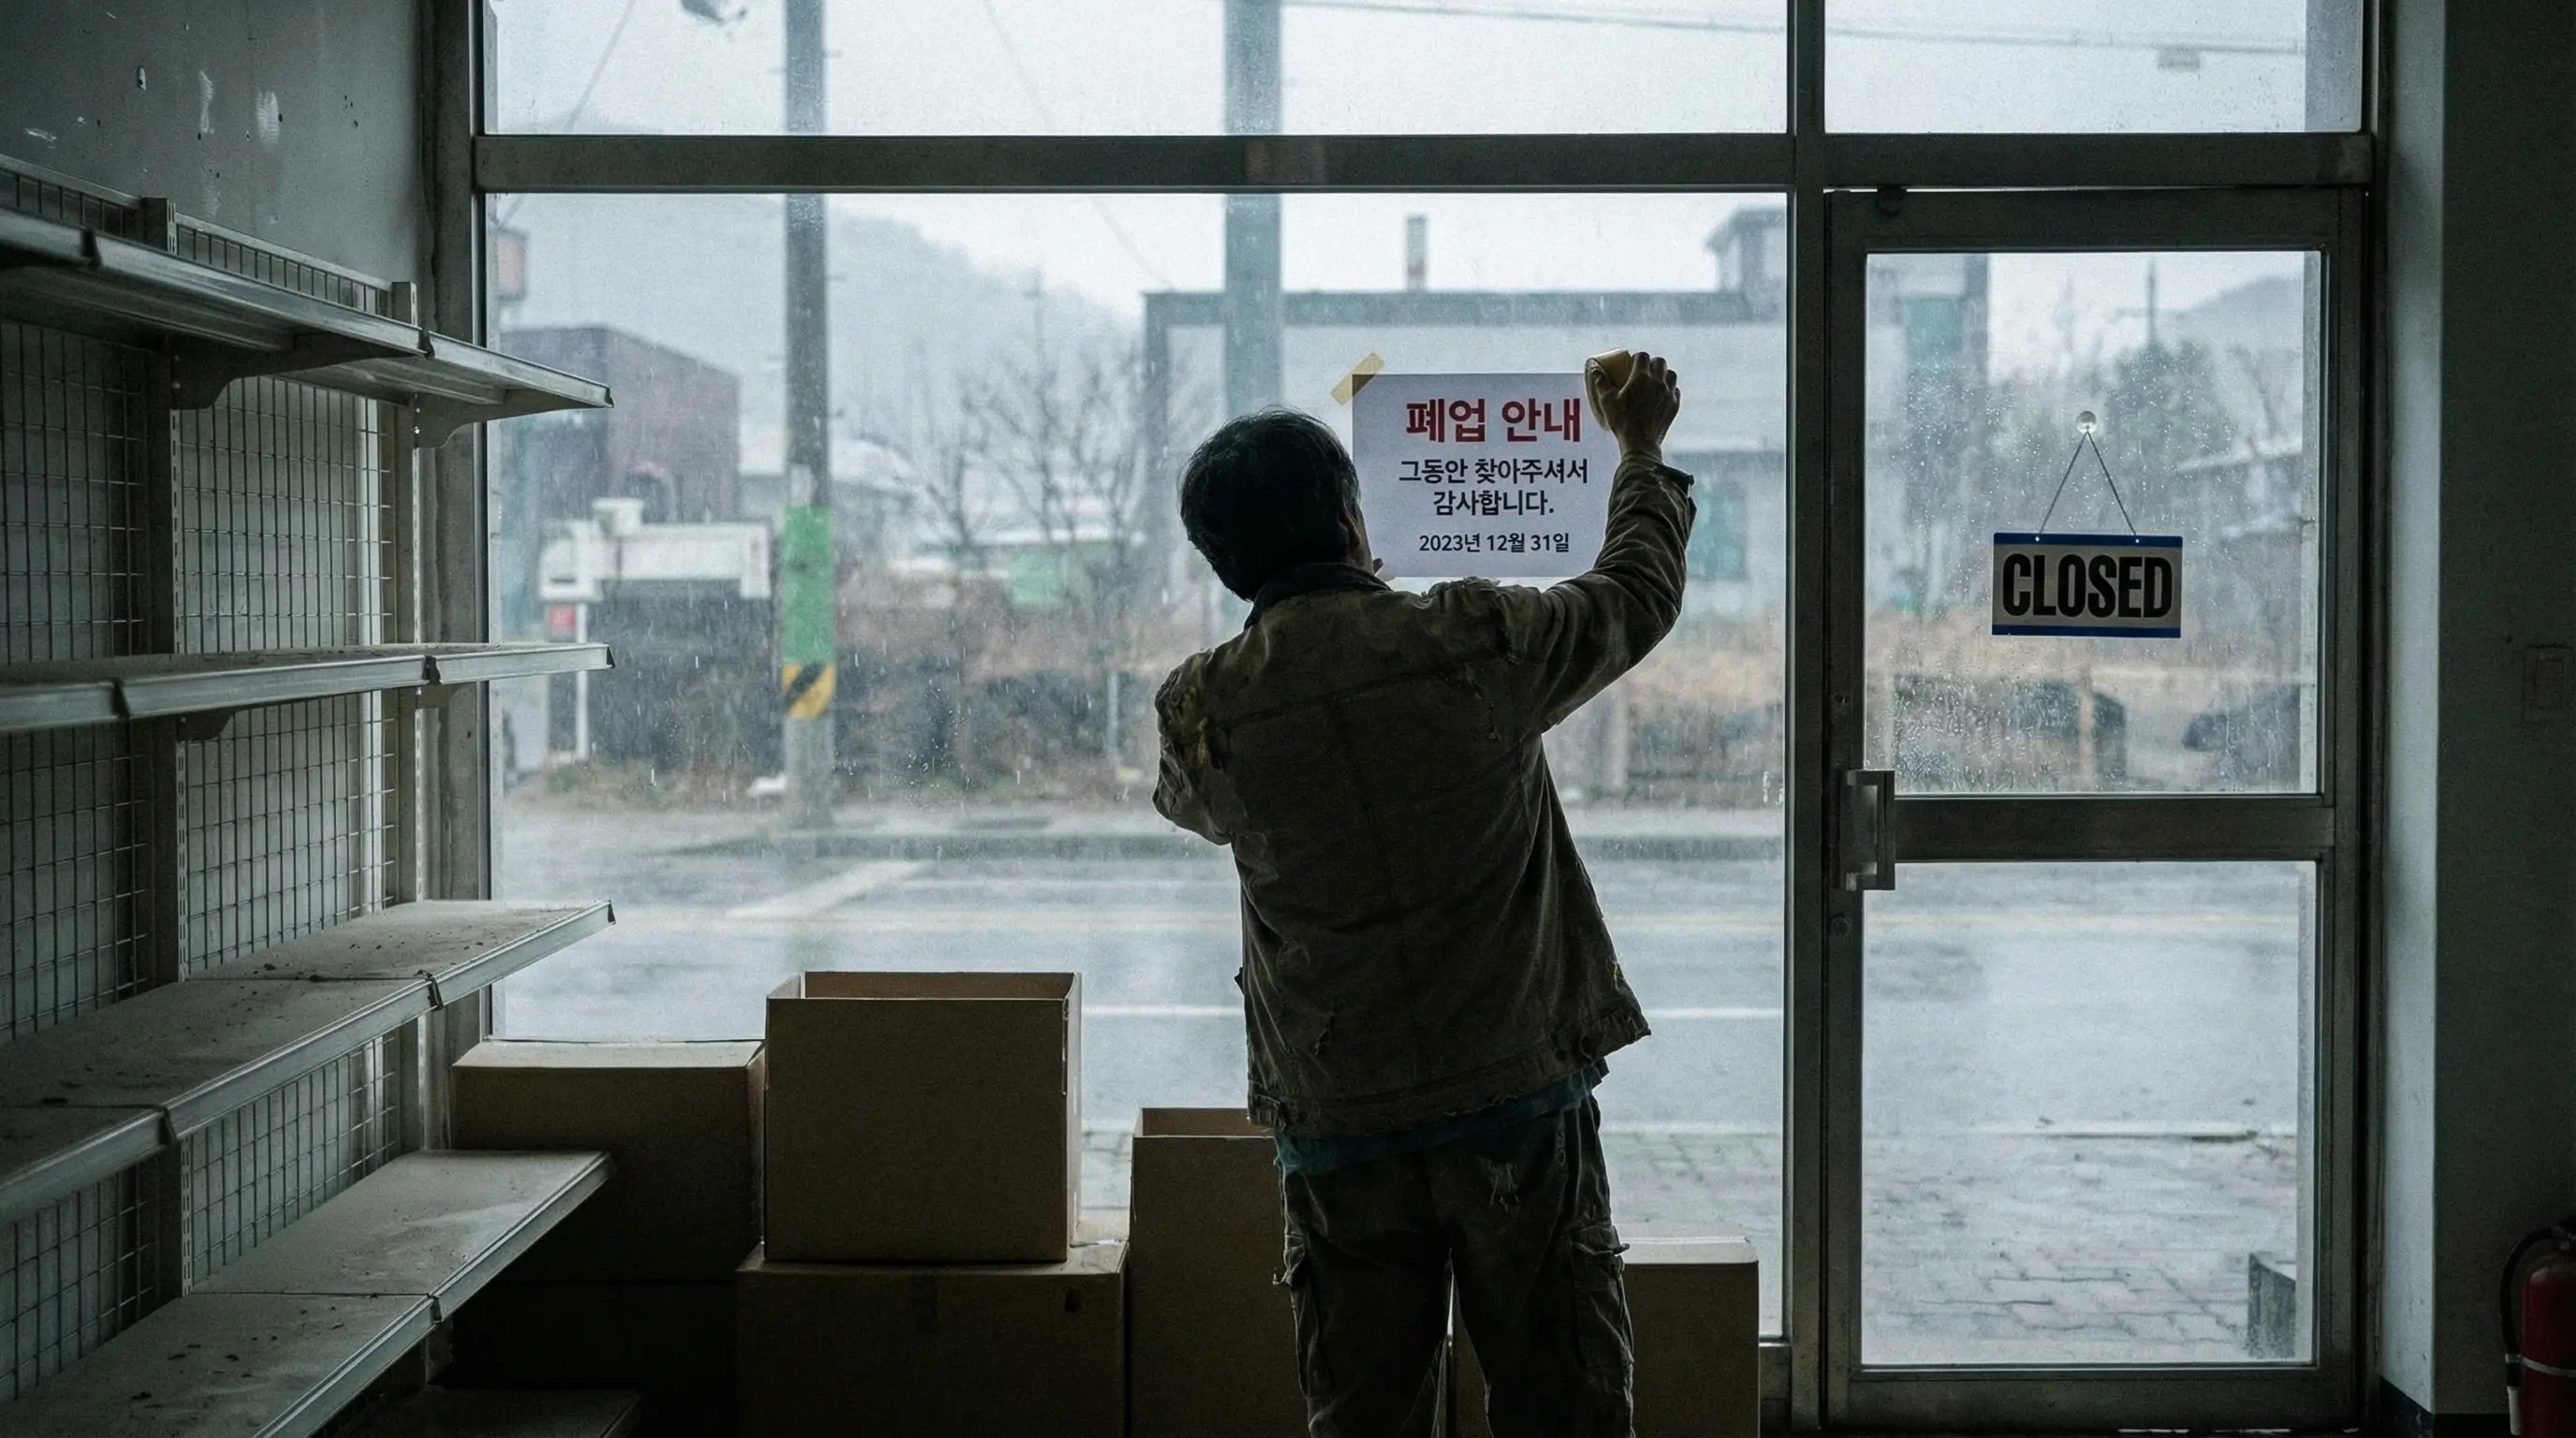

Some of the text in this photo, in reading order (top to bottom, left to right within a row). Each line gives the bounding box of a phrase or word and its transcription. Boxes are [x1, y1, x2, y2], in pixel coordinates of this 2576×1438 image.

[1406, 398, 1581, 442] 폐업 안내
[1398, 458, 1588, 484] 그동안 찾아주셔서
[1433, 490, 1554, 516] 감사합니다.
[1419, 533, 1570, 553] 2023년 12월 31일
[2002, 553, 2173, 618] CLOSED
